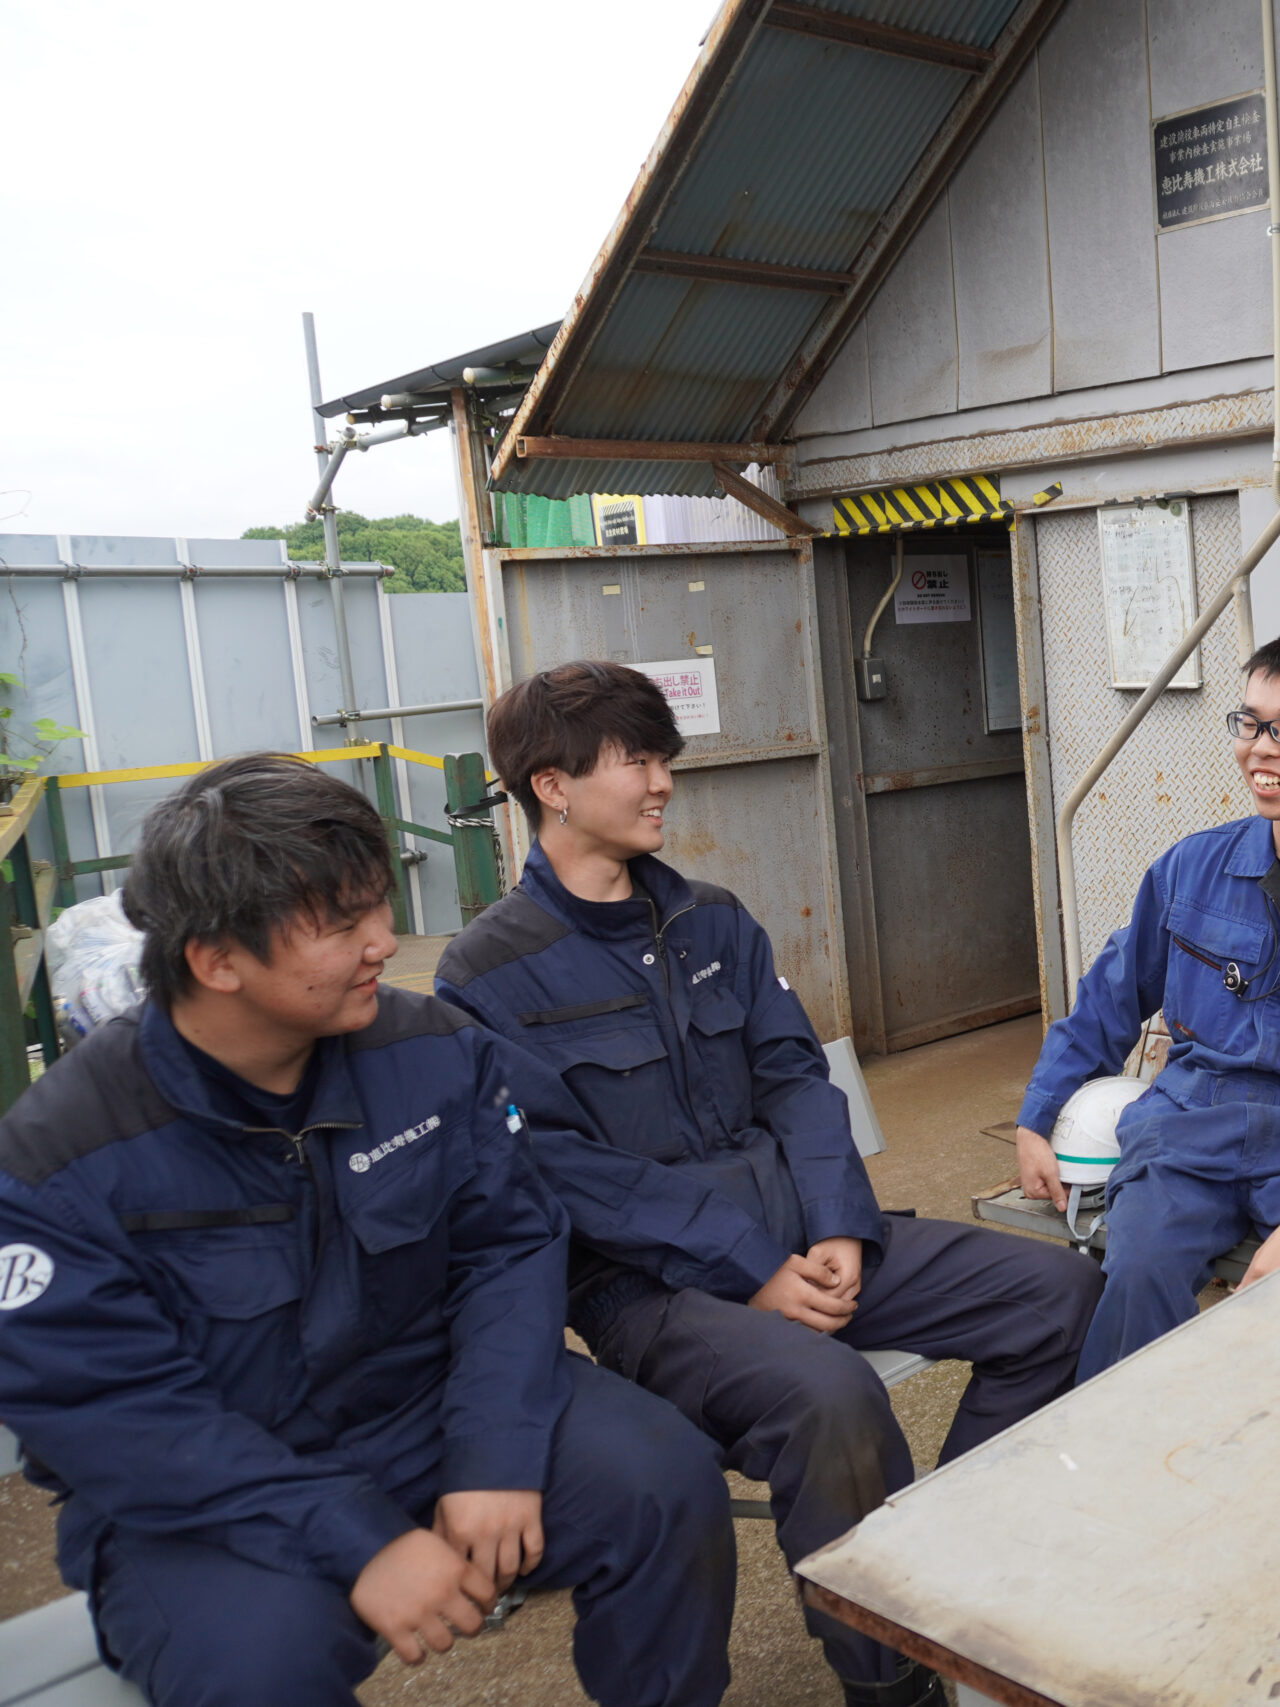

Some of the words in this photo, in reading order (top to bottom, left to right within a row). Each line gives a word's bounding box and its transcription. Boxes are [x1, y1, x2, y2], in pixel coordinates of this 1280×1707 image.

[1161, 152, 1264, 196] 恵比寿機工株式会社
[651, 674, 700, 689] ち出し禁止
[688, 686, 701, 696] Out
